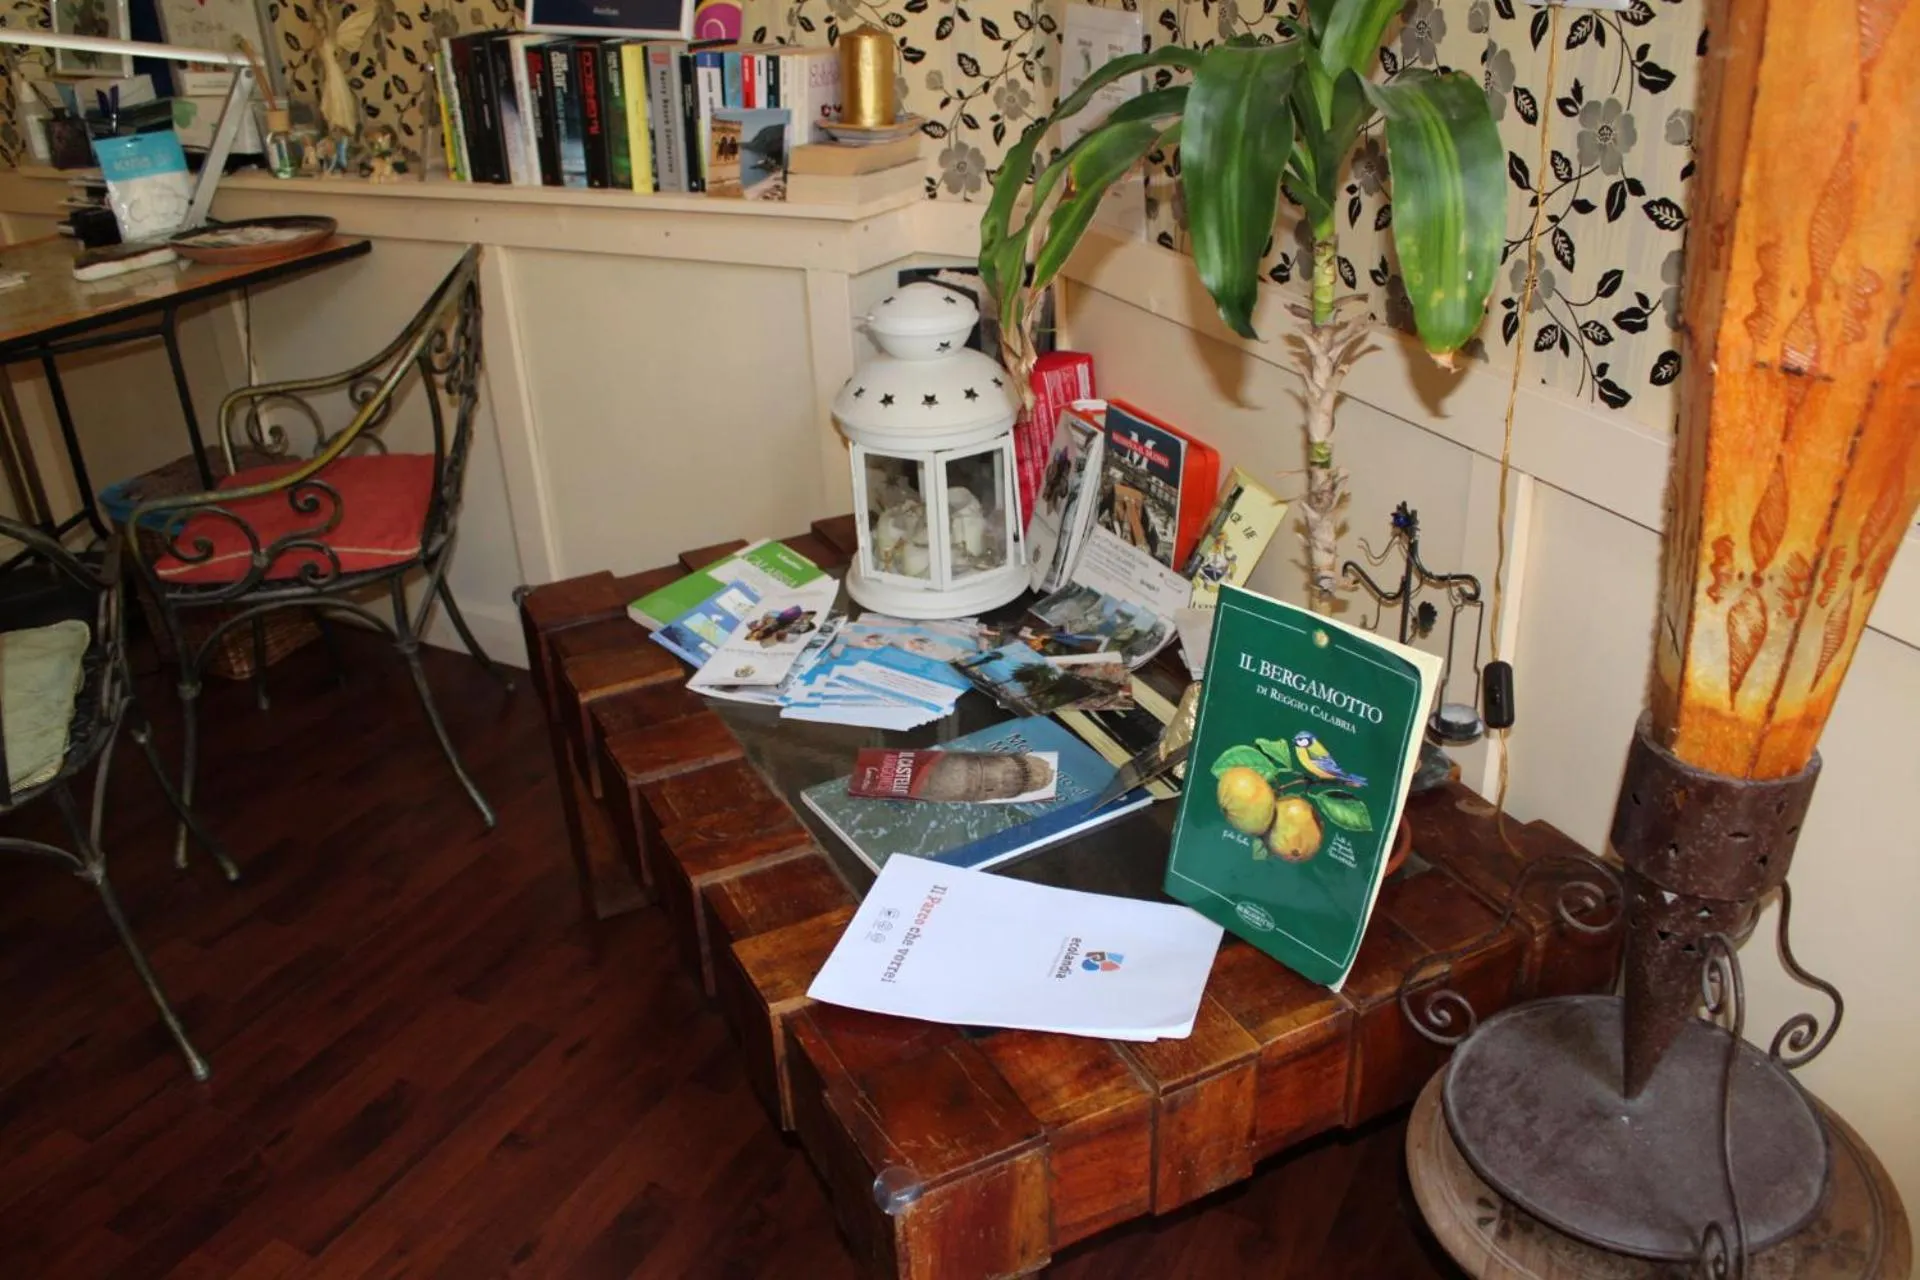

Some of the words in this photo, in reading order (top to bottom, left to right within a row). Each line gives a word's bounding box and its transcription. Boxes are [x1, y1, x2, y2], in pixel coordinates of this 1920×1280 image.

[1238, 651, 1256, 673] IL
[1259, 658, 1384, 725] BERGAMOTTO
[1255, 684, 1268, 697] DI
[1269, 687, 1309, 713] REGGIO
[1309, 704, 1357, 735] CALABRIA
[929, 884, 948, 895] Il
[914, 895, 943, 926] Parco
[902, 926, 922, 947] che
[880, 947, 910, 984] vorrei
[1055, 937, 1082, 979] ecolandia
